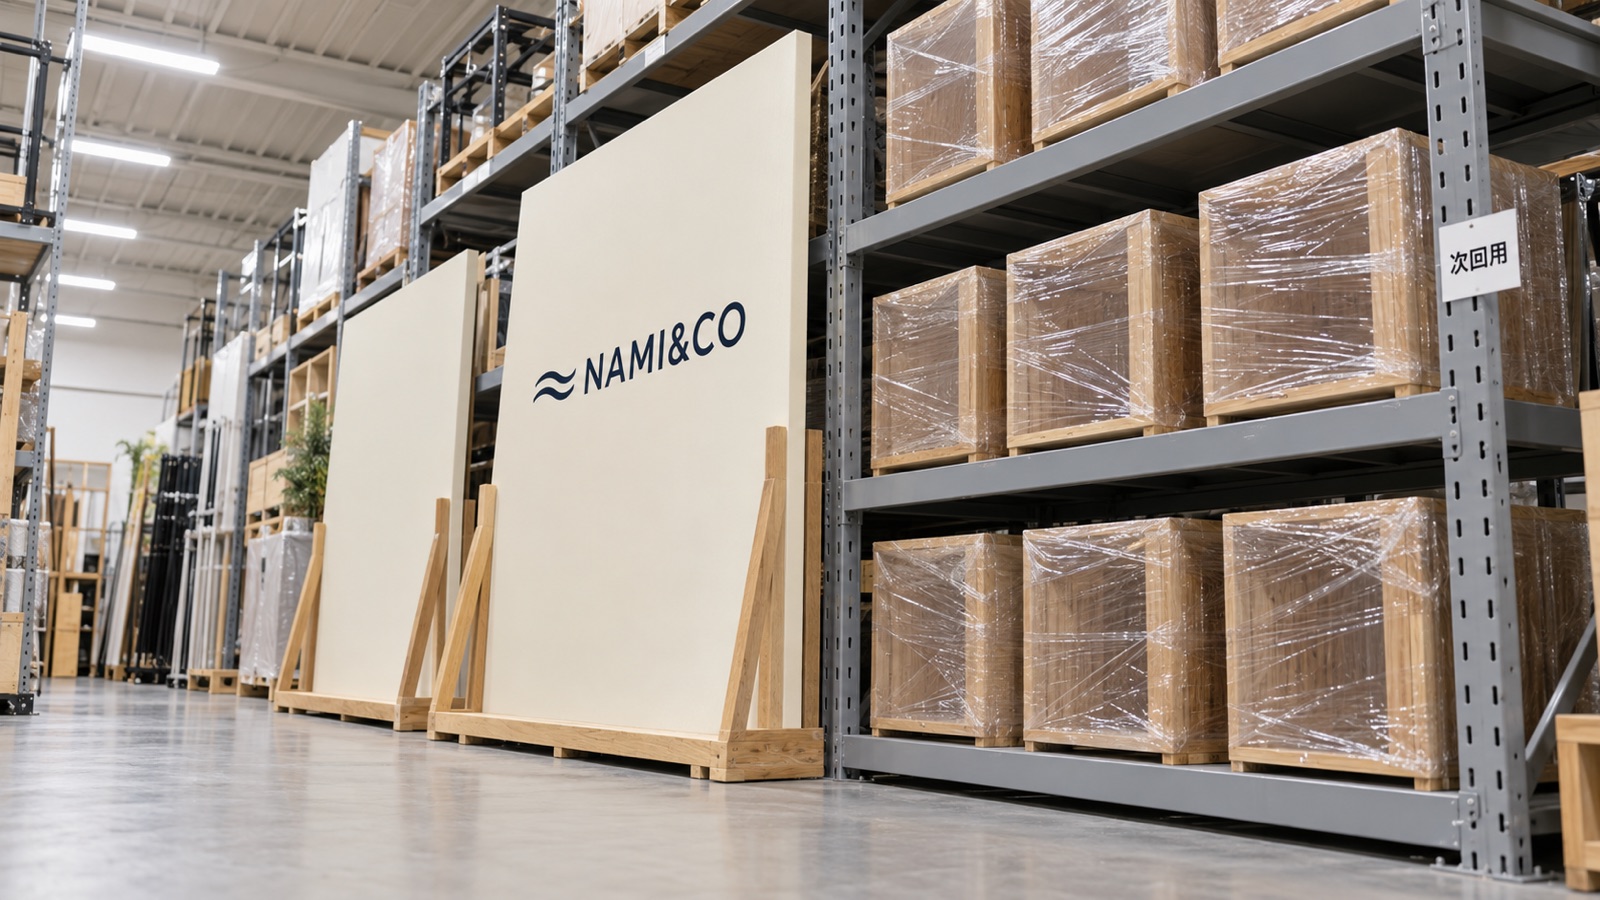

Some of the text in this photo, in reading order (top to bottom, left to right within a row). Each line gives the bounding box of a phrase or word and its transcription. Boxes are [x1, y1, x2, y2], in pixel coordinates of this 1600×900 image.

[1450, 241, 1508, 275] 次回用
[584, 301, 746, 395] NAMI&CO
